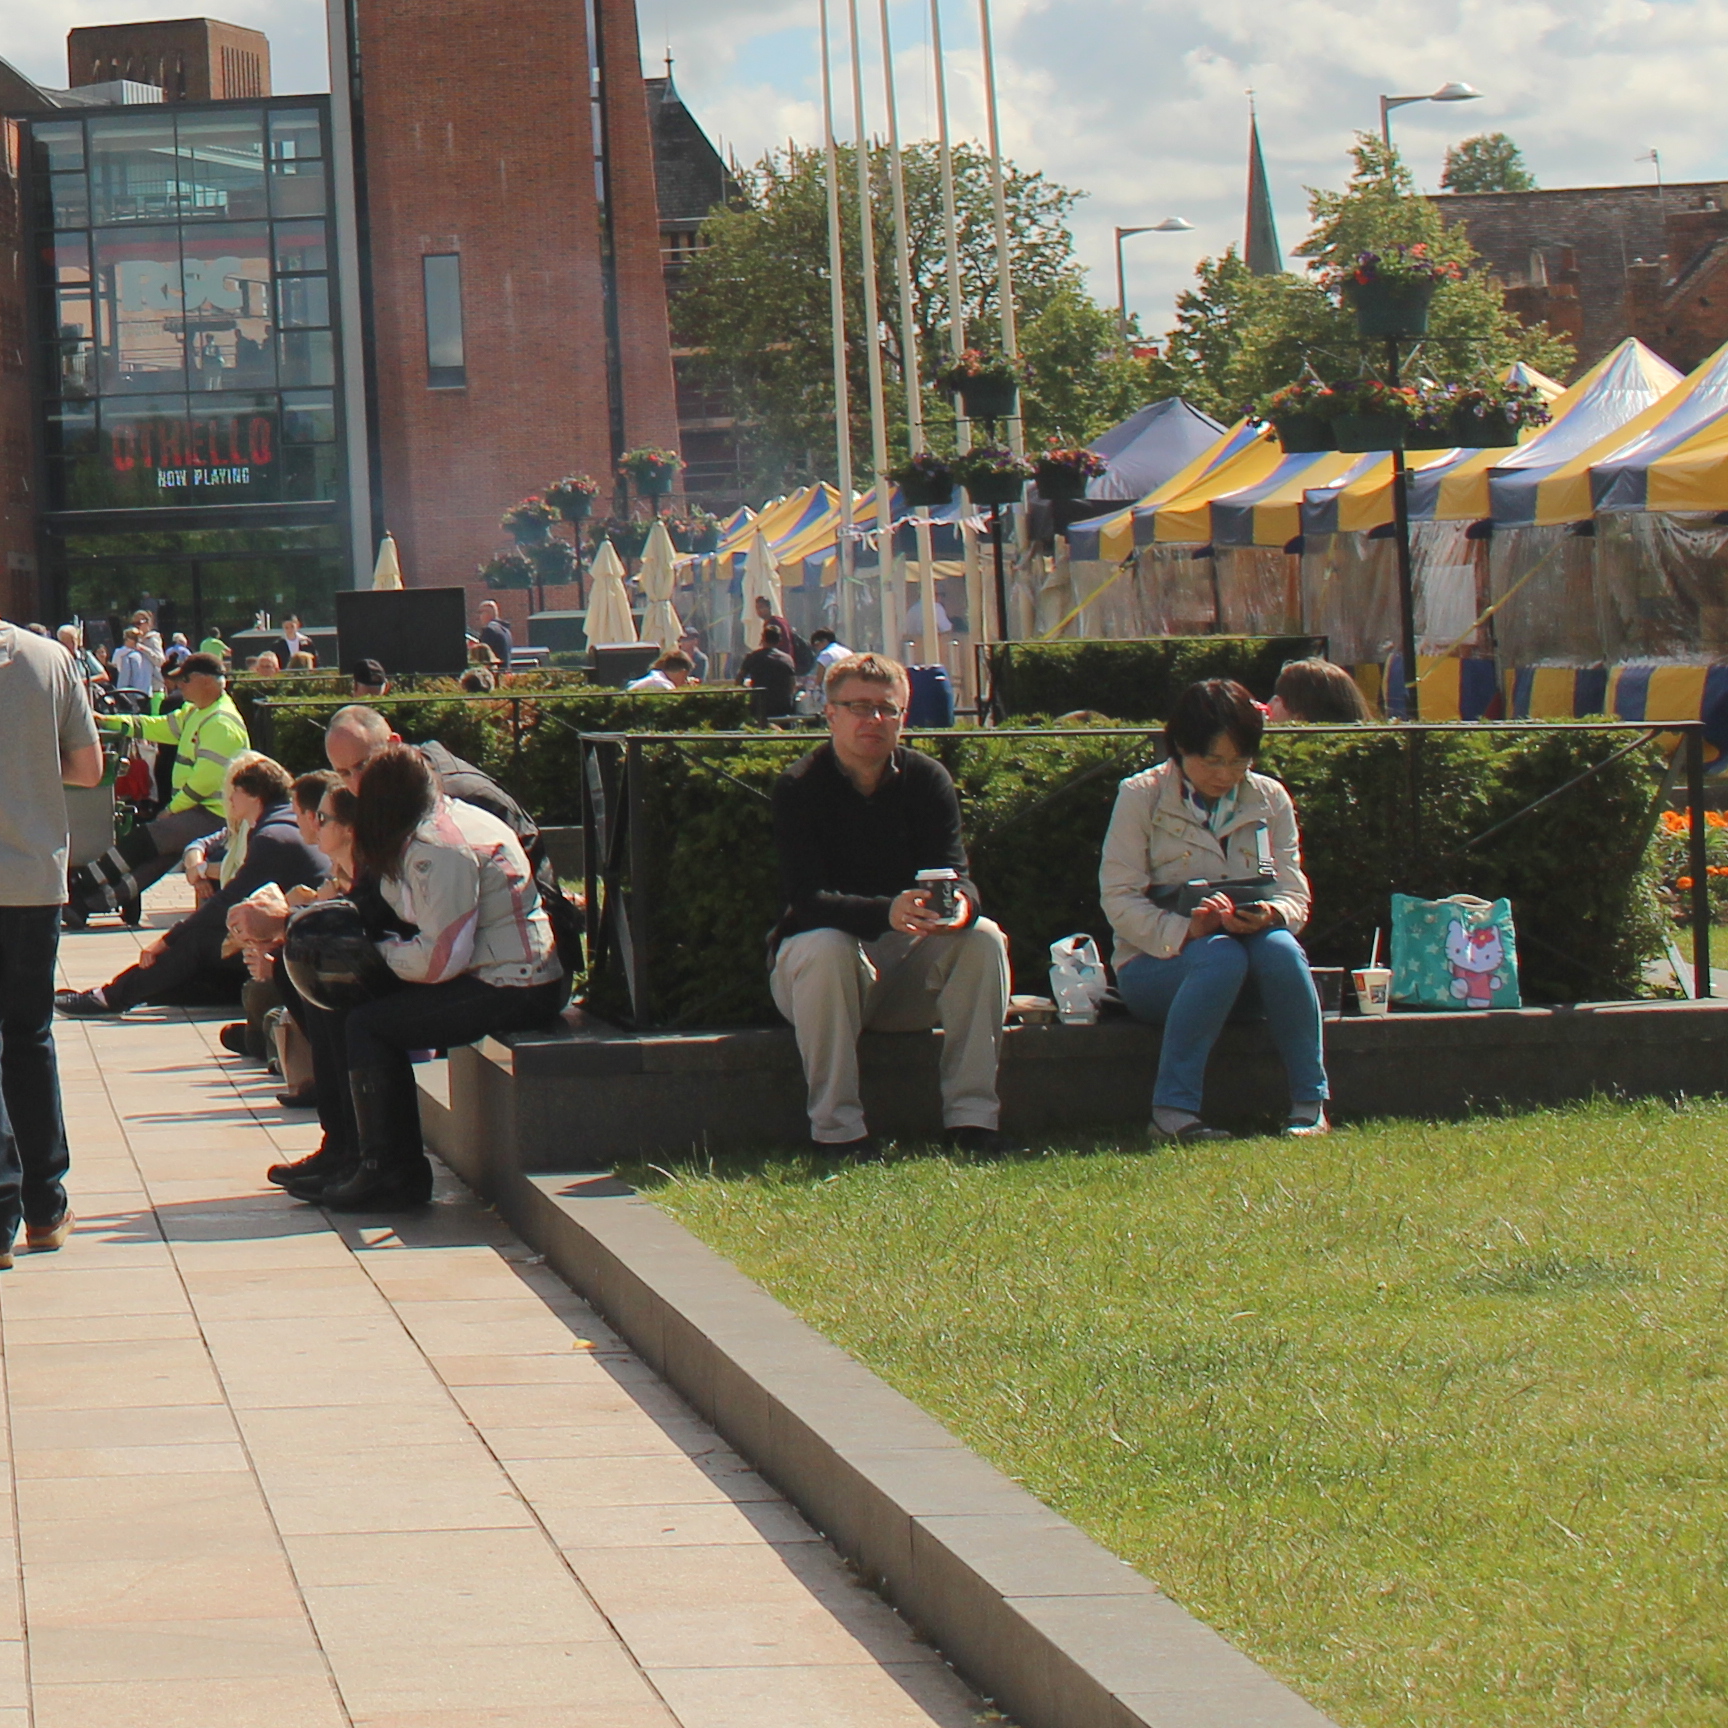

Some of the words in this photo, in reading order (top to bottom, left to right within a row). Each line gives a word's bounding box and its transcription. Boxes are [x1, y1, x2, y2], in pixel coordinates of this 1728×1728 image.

[111, 418, 273, 472] OTHELLO
[157, 469, 189, 489] NOW
[193, 466, 251, 486] PLAYING
